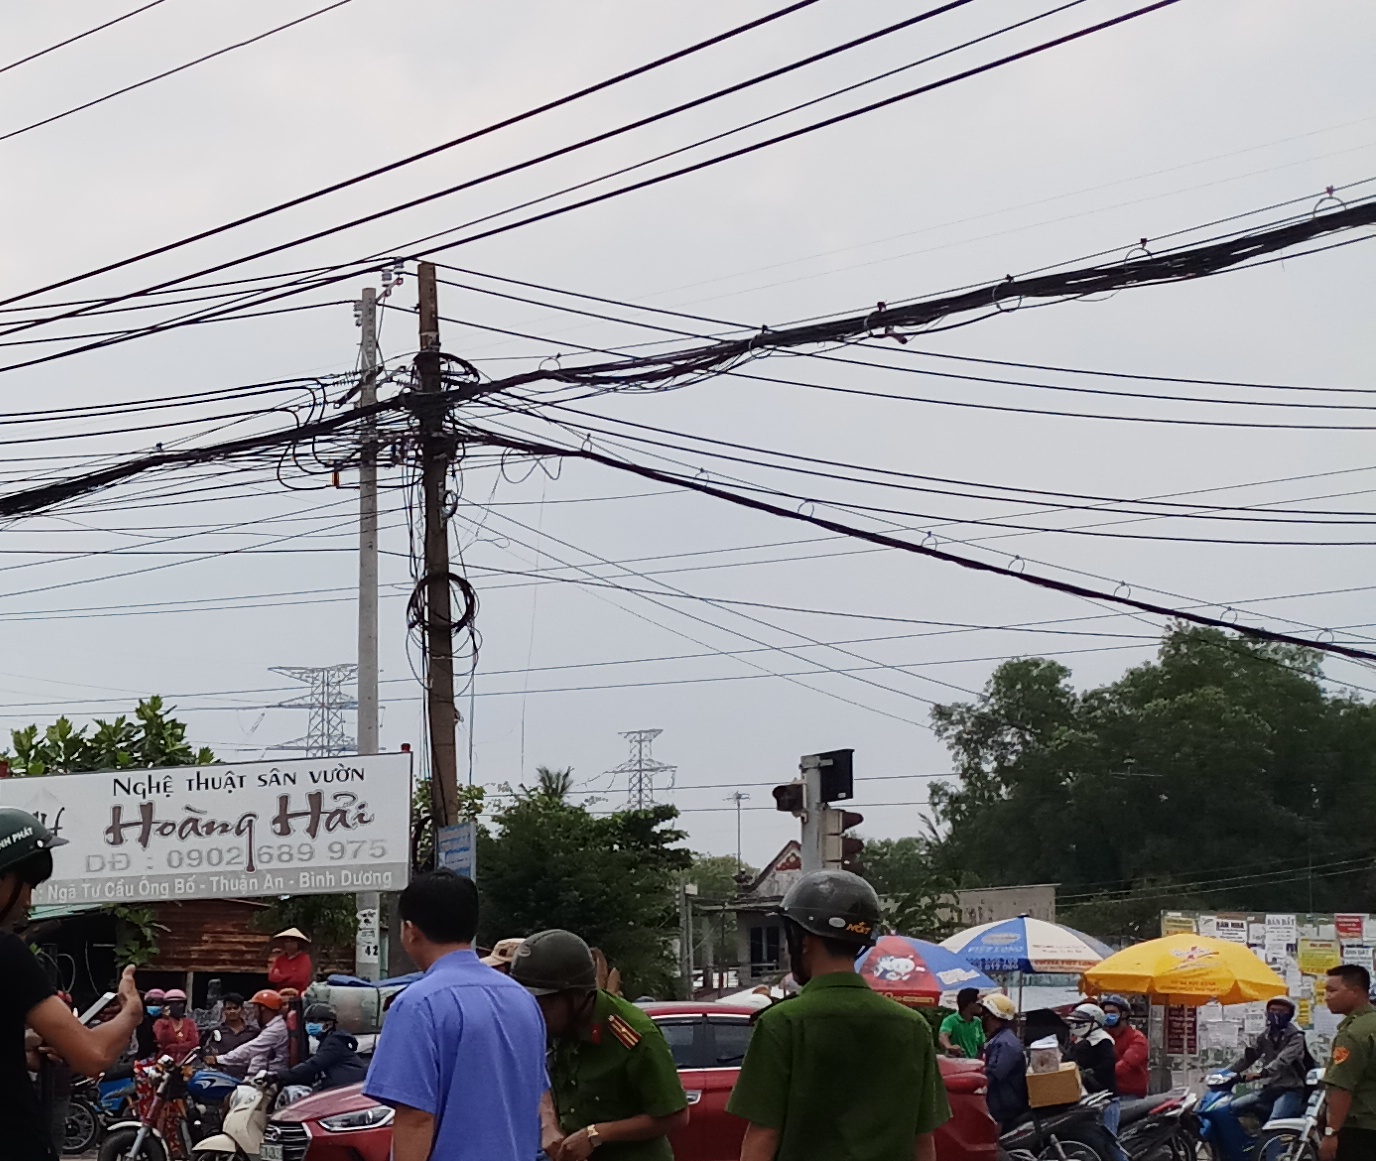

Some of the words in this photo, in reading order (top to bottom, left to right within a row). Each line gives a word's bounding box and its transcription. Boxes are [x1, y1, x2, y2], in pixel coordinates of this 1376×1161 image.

[104, 800, 258, 873] Hoàng
[271, 789, 376, 840] Hải
[166, 846, 245, 869] 0902
[256, 843, 316, 864] 689
[327, 839, 388, 861] 975
[47, 884, 77, 902] Ngã
[82, 881, 101, 898] Tư
[174, 874, 196, 894] Bố
[209, 875, 259, 895] Thuận
[299, 870, 336, 889] Bình
[341, 869, 392, 889] Dương
